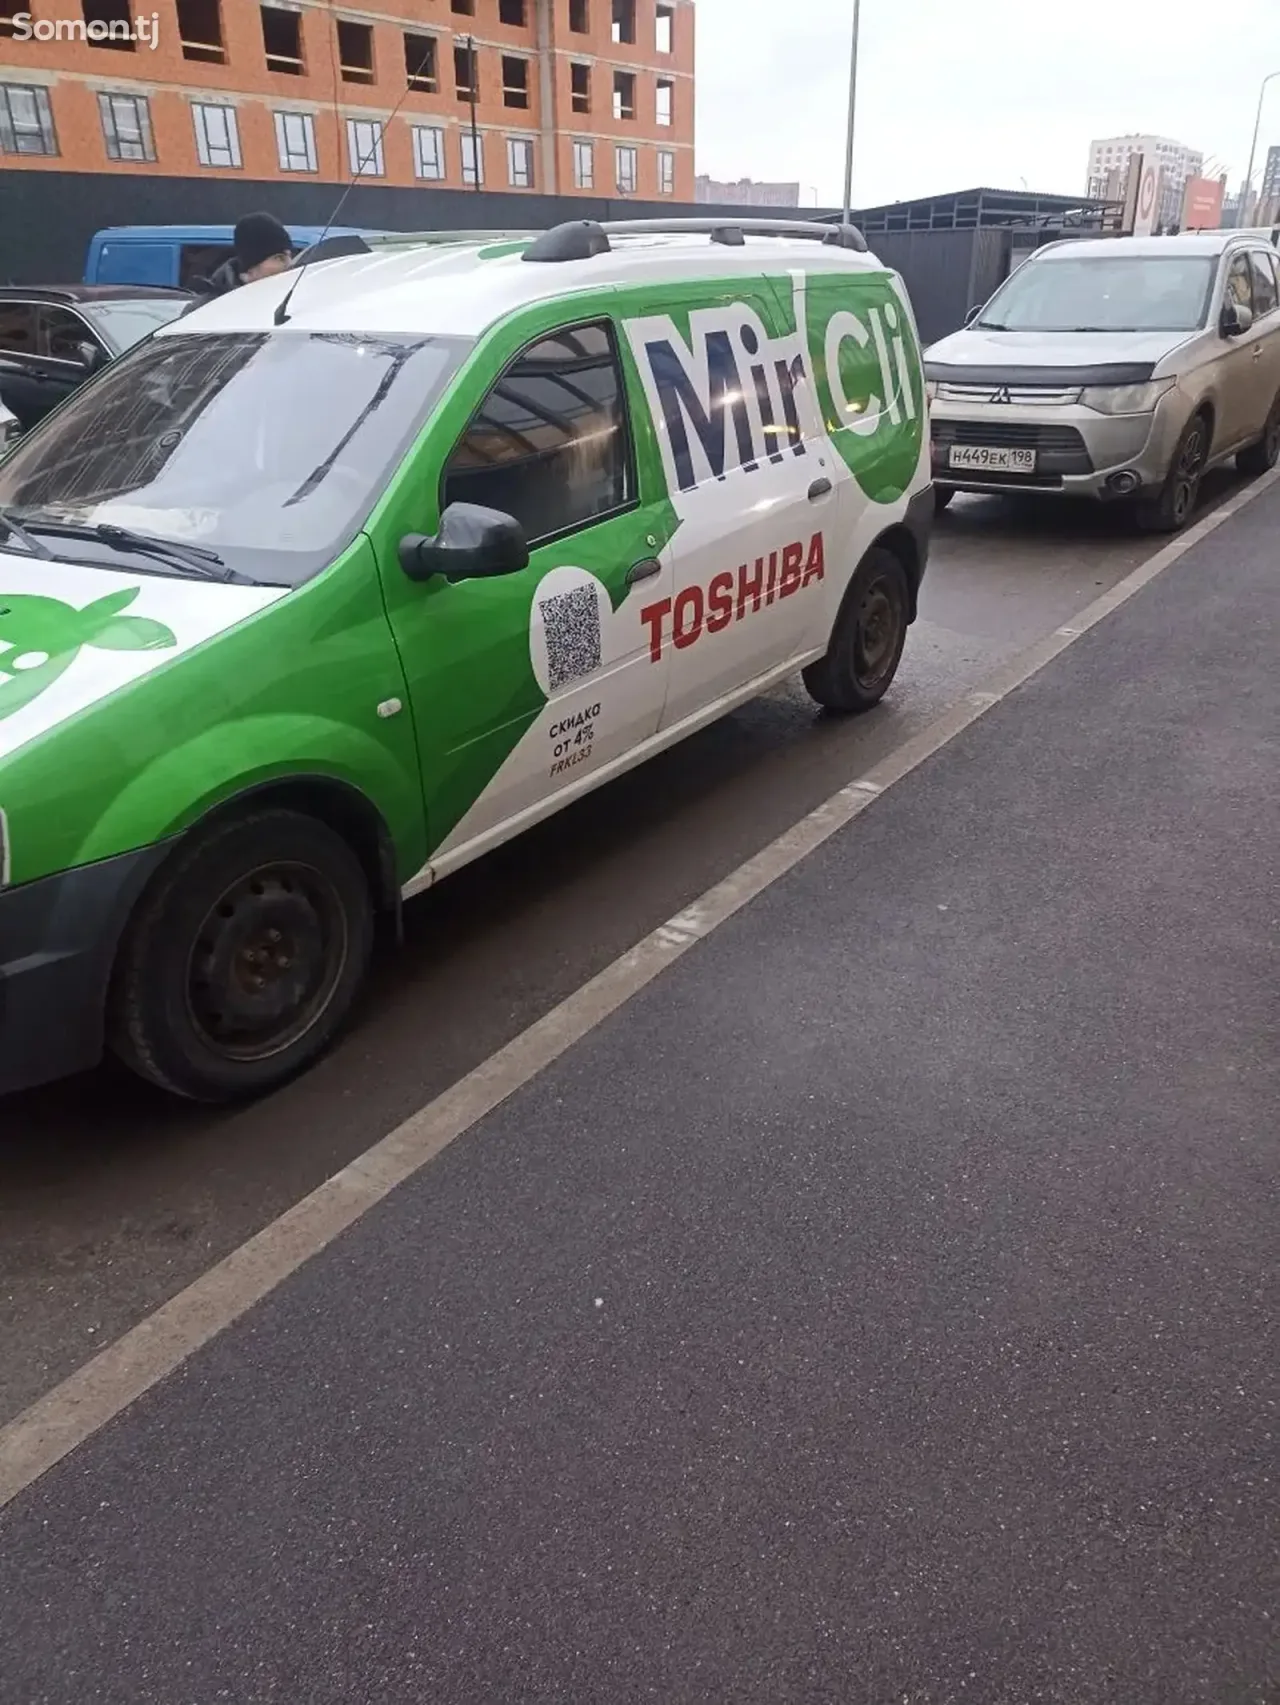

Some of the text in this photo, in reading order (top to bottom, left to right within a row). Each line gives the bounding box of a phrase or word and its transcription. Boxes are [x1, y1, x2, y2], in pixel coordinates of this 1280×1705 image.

[1011, 450, 1033, 463] 198
[640, 531, 825, 664] TOSHIBA
[574, 722, 594, 745] 4%
